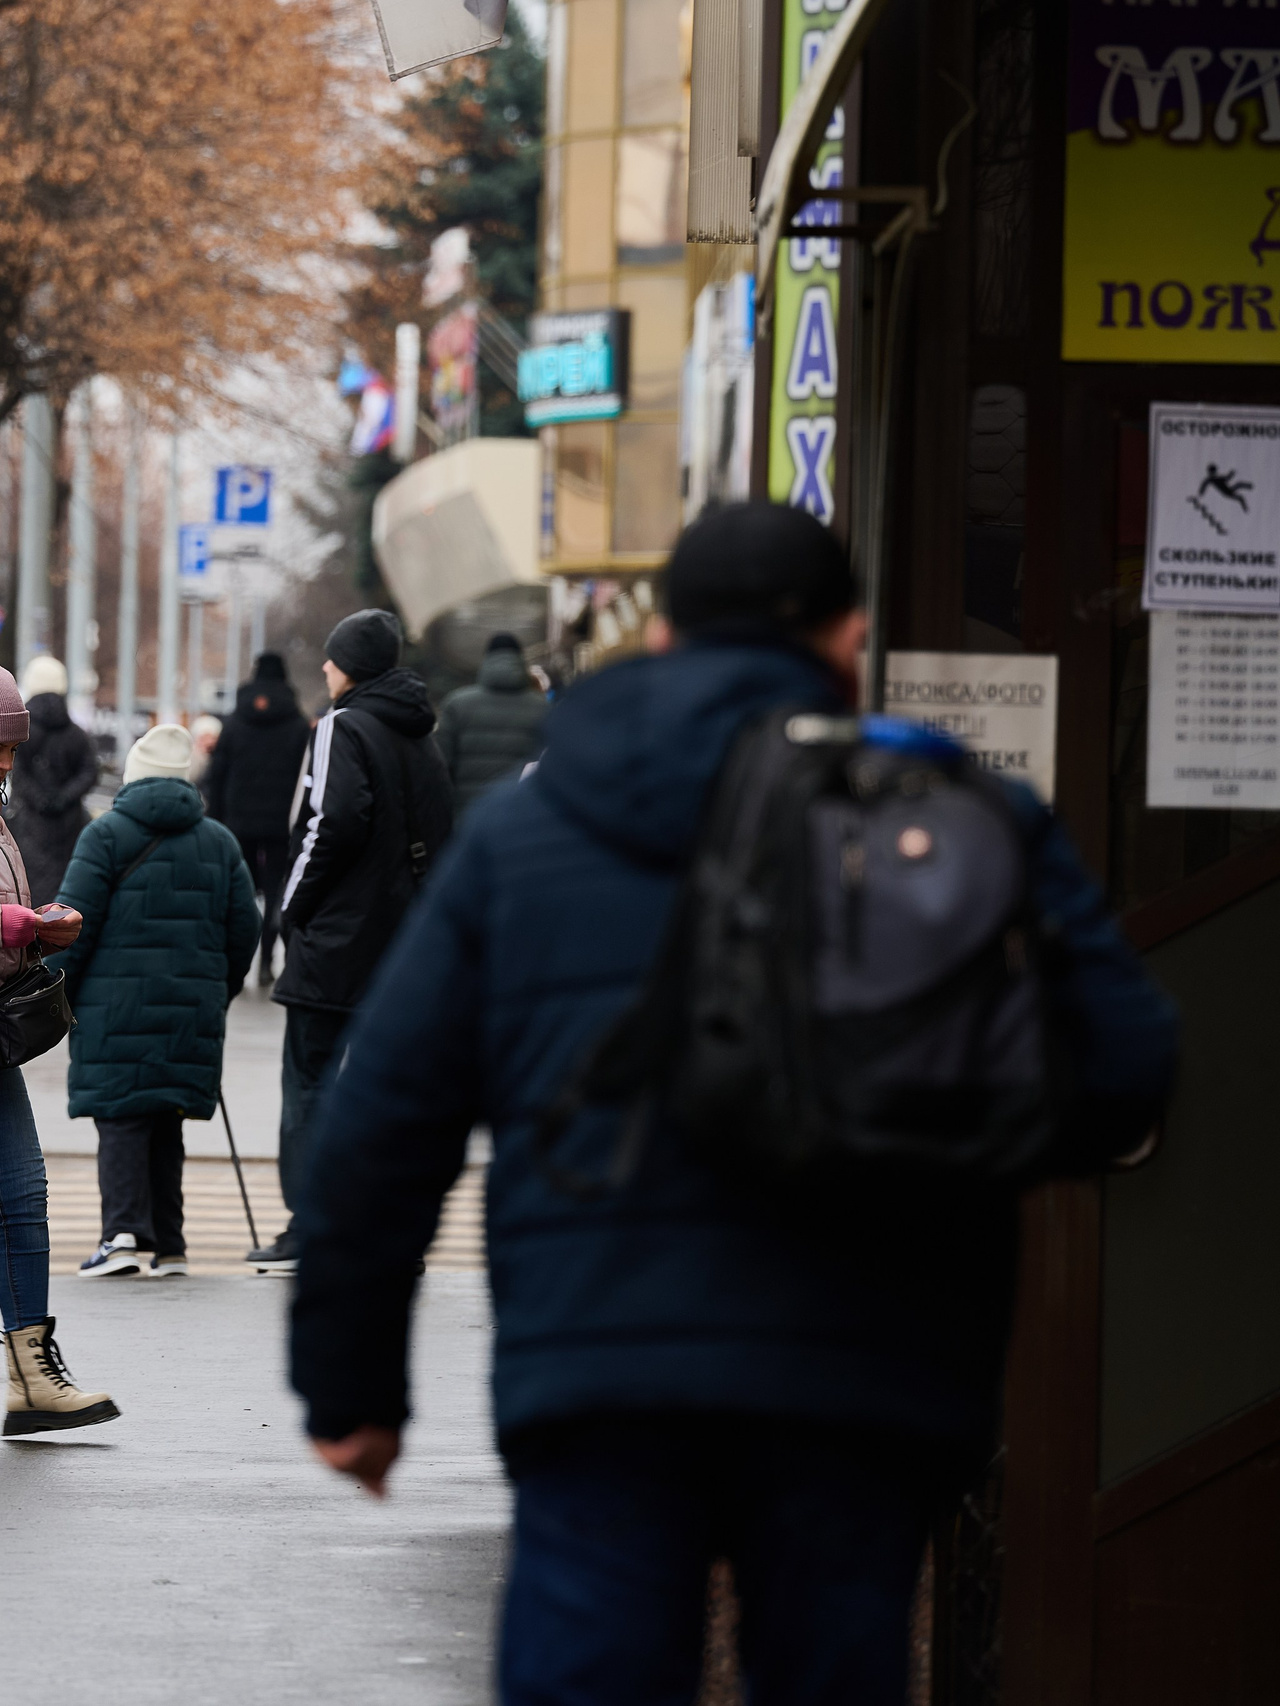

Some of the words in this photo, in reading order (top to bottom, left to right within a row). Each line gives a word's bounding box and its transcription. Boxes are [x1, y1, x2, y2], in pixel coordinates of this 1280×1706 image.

[225, 466, 267, 522] P
[1158, 548, 1276, 566] СКОЛЬЗКИЕ
[1155, 571, 1278, 590] СТУПЕНЬКИ!
